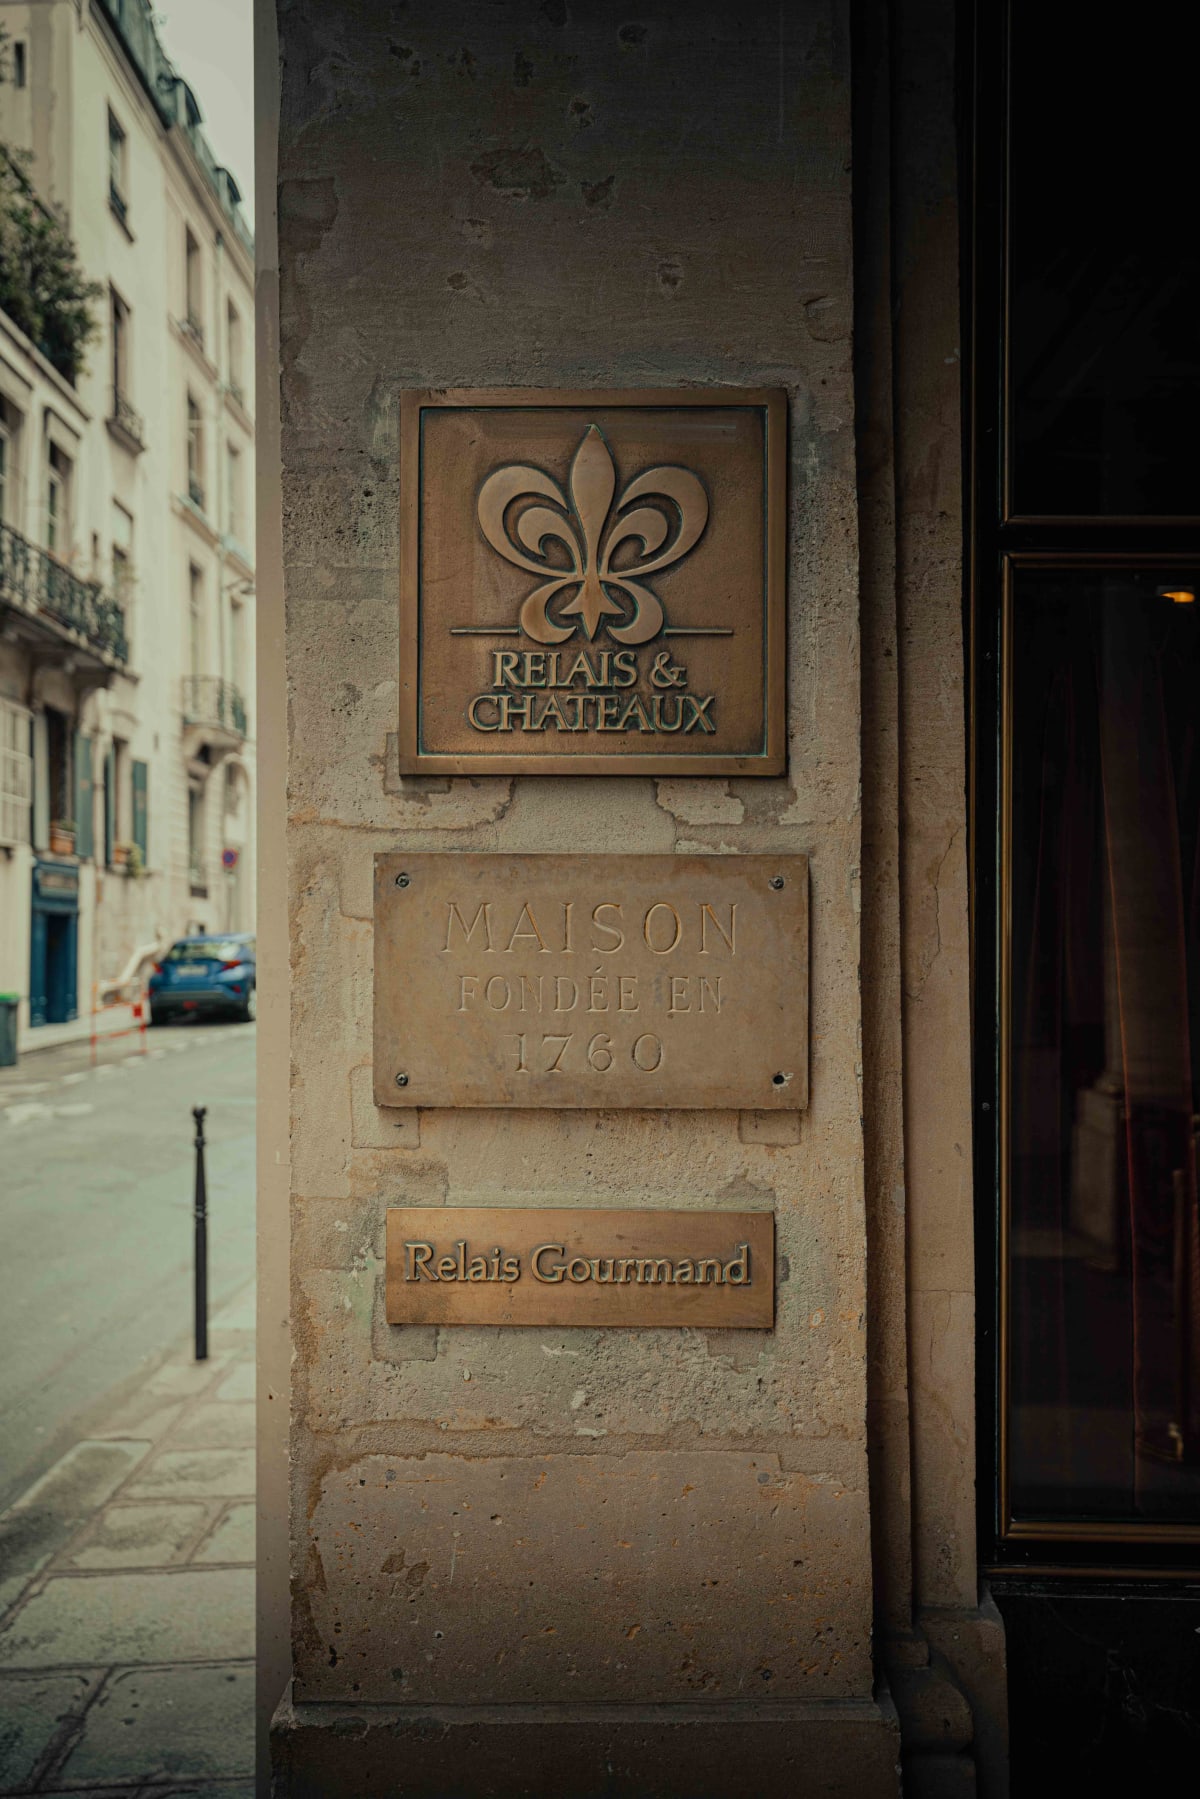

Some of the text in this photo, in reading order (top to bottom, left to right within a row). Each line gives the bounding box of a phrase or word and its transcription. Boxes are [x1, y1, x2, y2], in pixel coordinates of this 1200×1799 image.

[492, 650, 688, 688] RELAIS &
[466, 694, 716, 733] CHATEAUX
[441, 902, 738, 955] MAISON
[456, 966, 722, 1013] FONDÉE EN
[511, 1033, 664, 1073] 1760
[405, 1241, 751, 1285] Relais Gourmand
